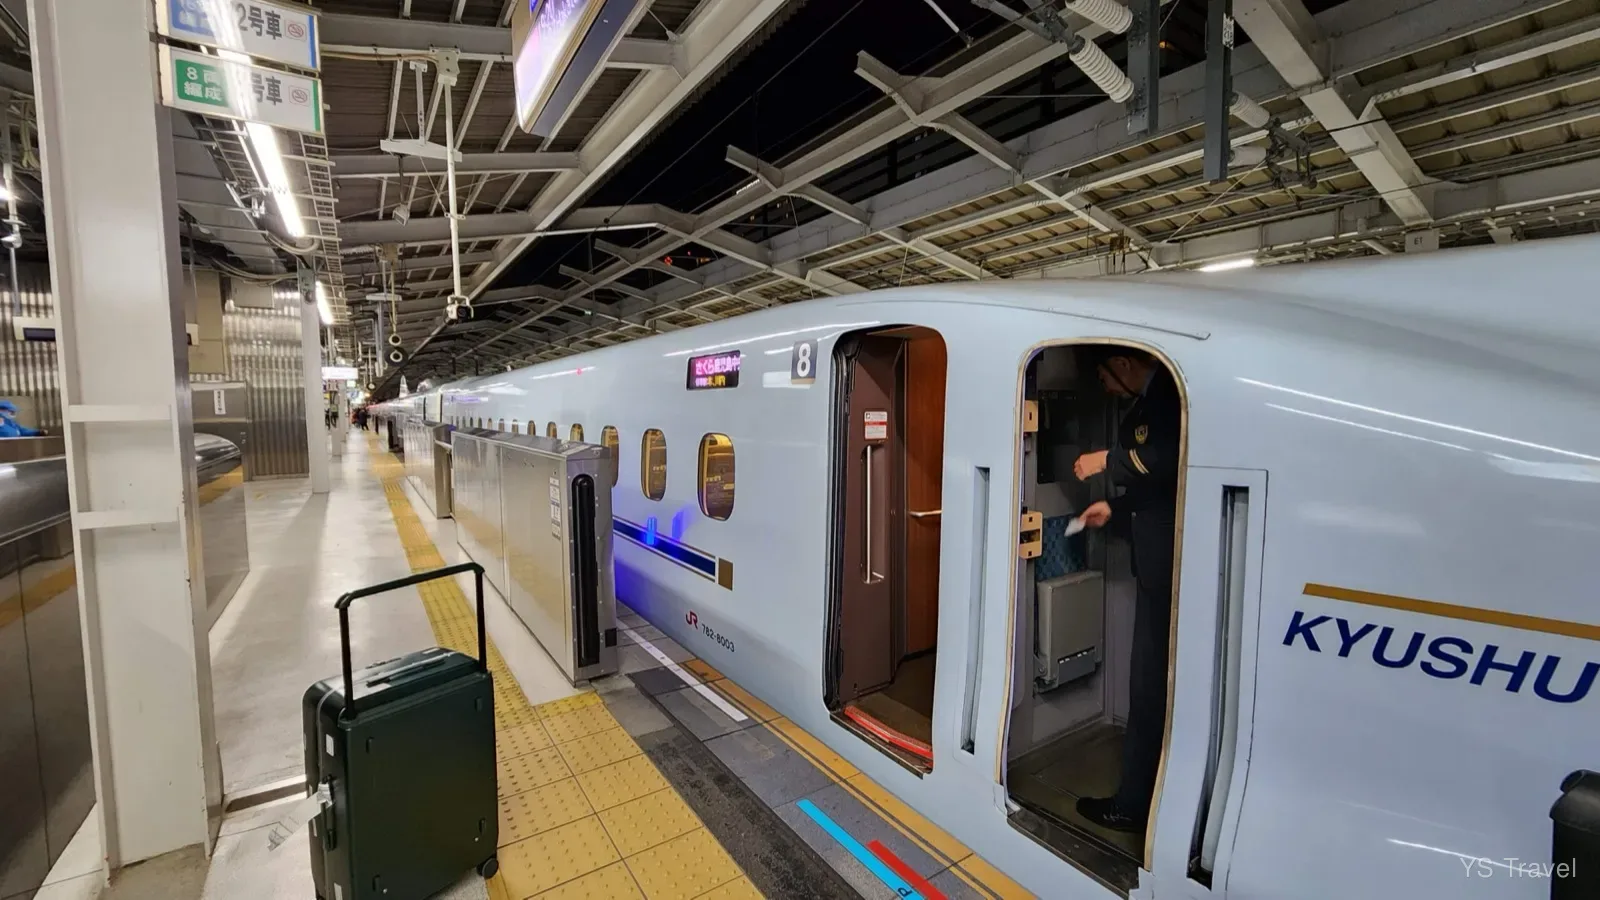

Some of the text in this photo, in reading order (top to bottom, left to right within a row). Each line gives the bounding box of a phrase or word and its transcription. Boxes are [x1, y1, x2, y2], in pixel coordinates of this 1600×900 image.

[250, 72, 282, 105] 号車
[797, 343, 811, 377] 8
[685, 610, 735, 653] JR 782-8003
[1282, 611, 1600, 703] KYUSHU
